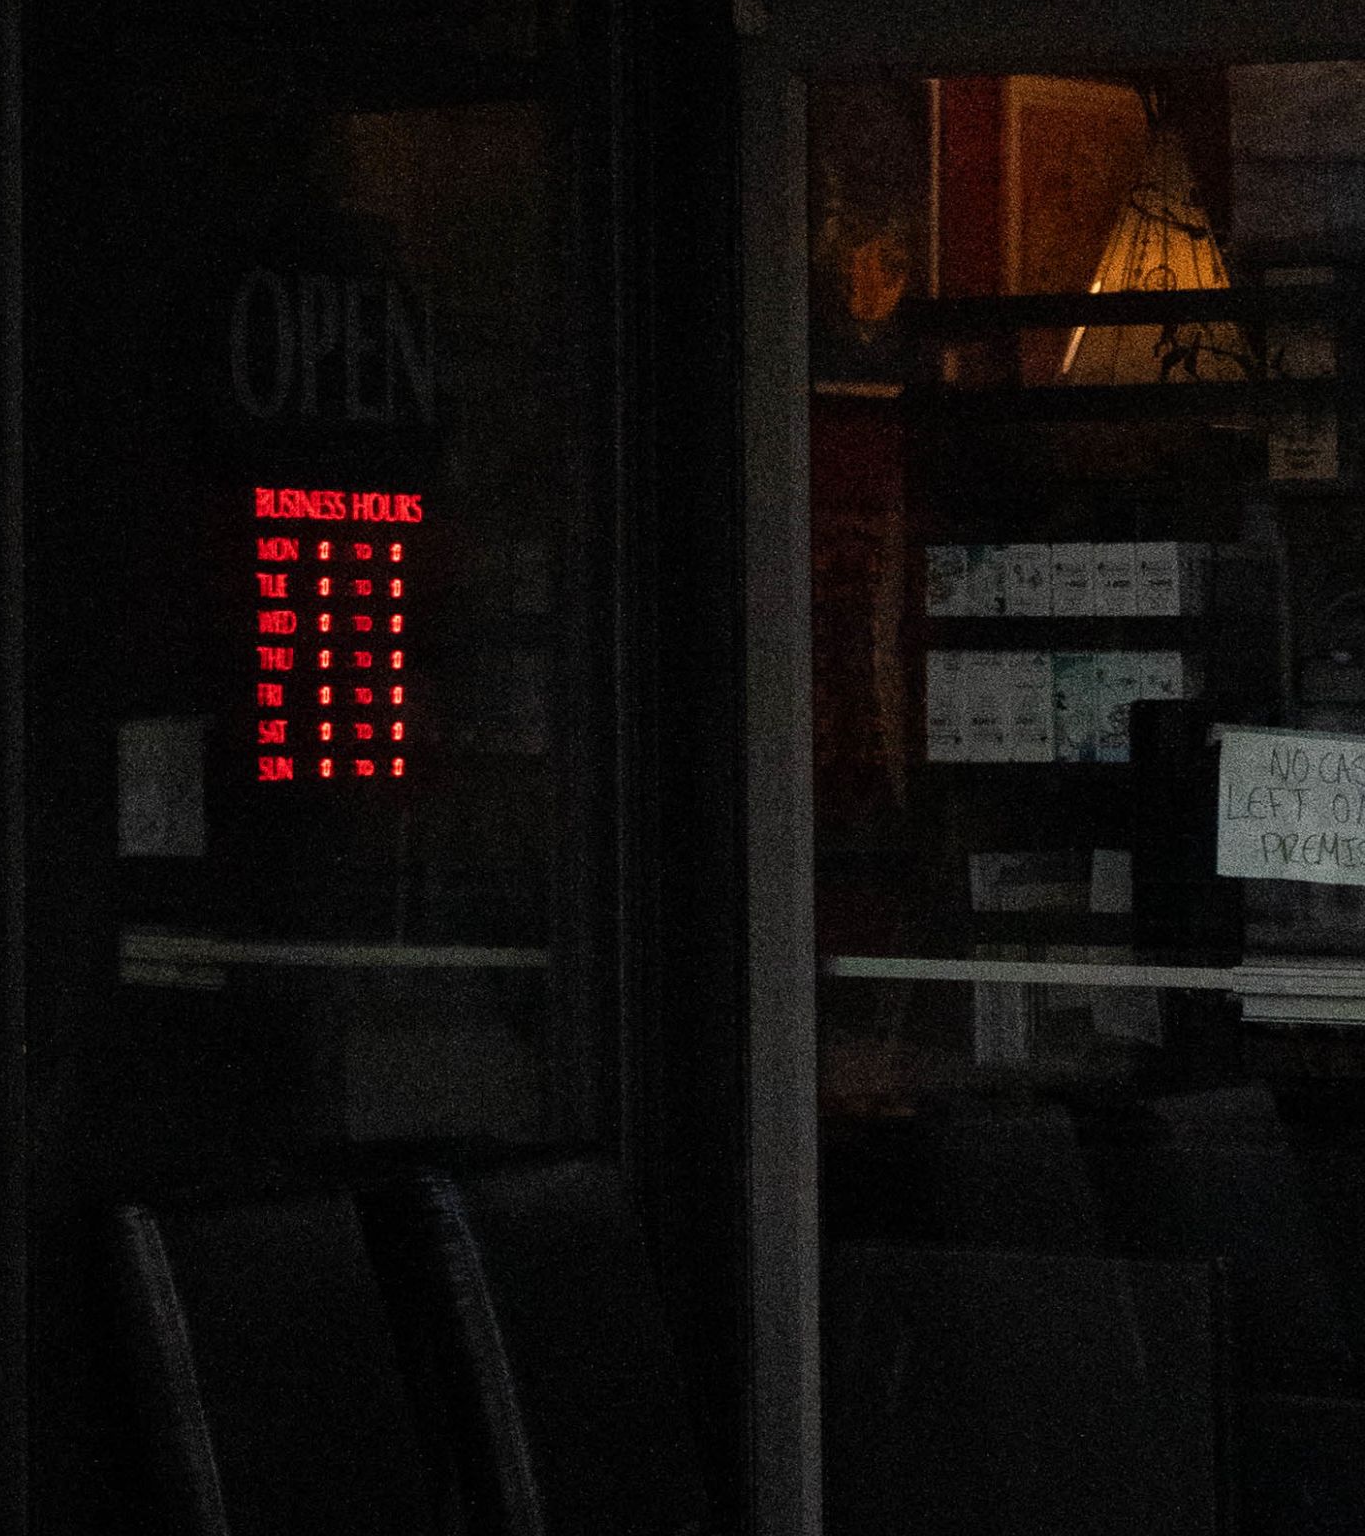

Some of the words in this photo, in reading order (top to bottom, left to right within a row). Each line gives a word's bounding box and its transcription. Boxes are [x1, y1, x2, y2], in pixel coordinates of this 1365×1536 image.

[228, 265, 435, 425] OPEN
[255, 488, 346, 520] BUSINESS
[352, 492, 423, 523] HOURS
[257, 537, 299, 561] MON
[256, 572, 288, 598] TUE
[257, 610, 297, 634] WED
[256, 646, 294, 670] THU
[257, 683, 283, 707] FRI
[258, 720, 288, 744] SAT
[258, 756, 294, 781] SUN
[1269, 747, 1310, 783] NO
[1227, 783, 1311, 821] LEFT
